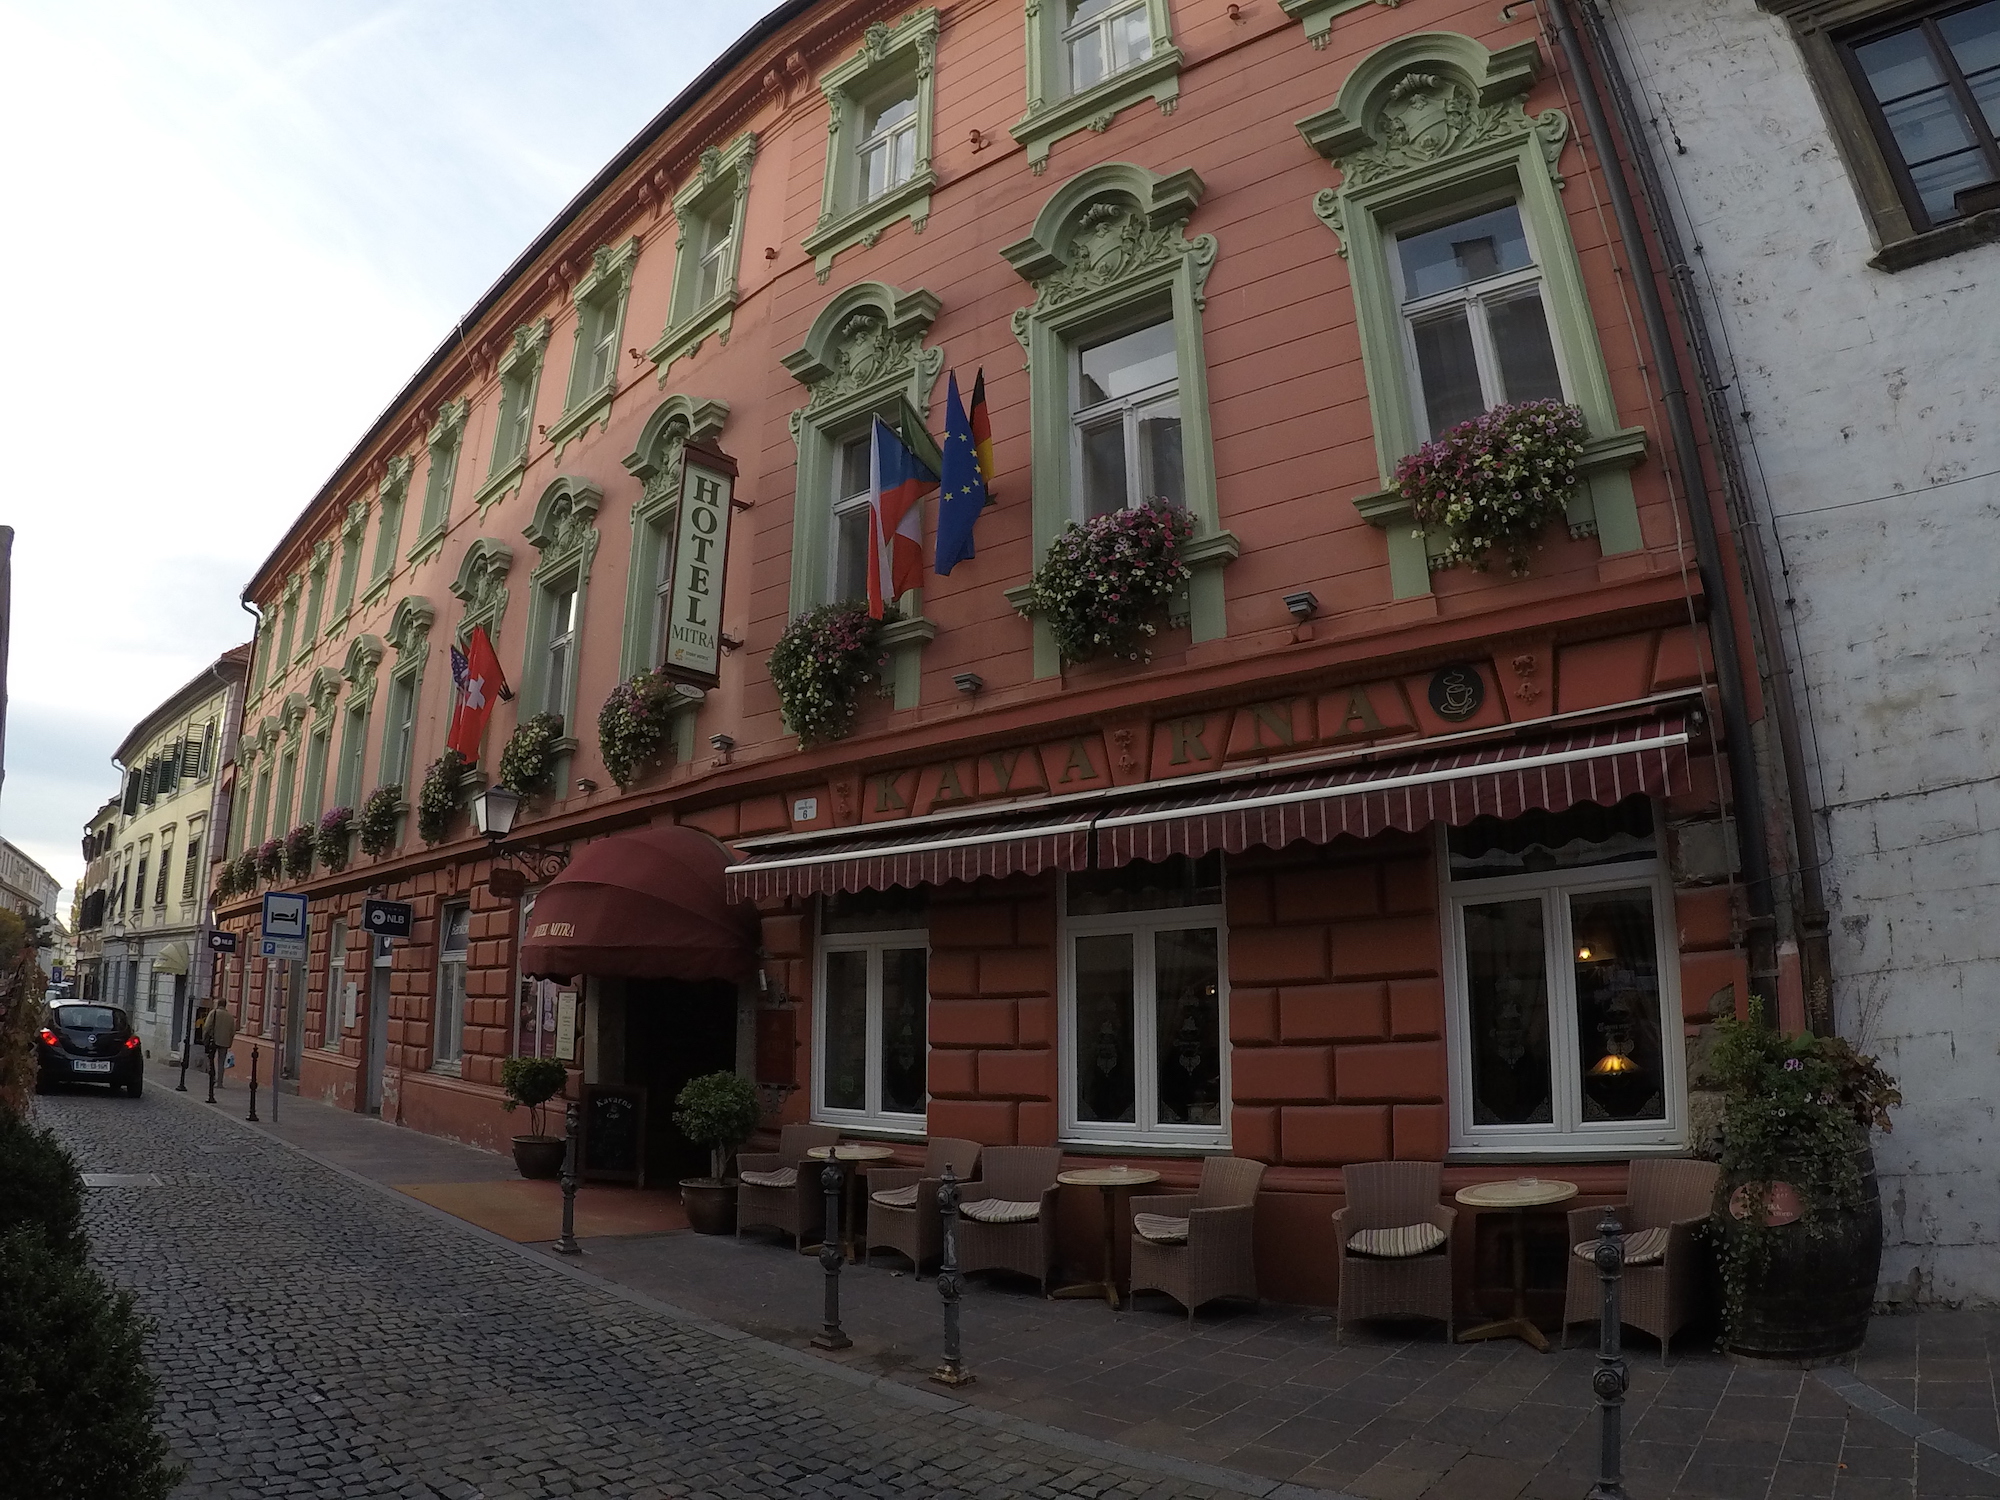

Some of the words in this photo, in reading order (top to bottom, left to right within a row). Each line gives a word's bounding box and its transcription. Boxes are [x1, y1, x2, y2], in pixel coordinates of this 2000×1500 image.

[685, 475, 722, 627] HOTEL
[671, 623, 716, 650] MITRA
[875, 684, 1387, 812] KAVARNA
[802, 809, 808, 820] 6
[386, 913, 405, 925] NLB
[550, 922, 576, 938] MITRA
[266, 943, 273, 952] P
[595, 1096, 633, 1111] Kavarna
